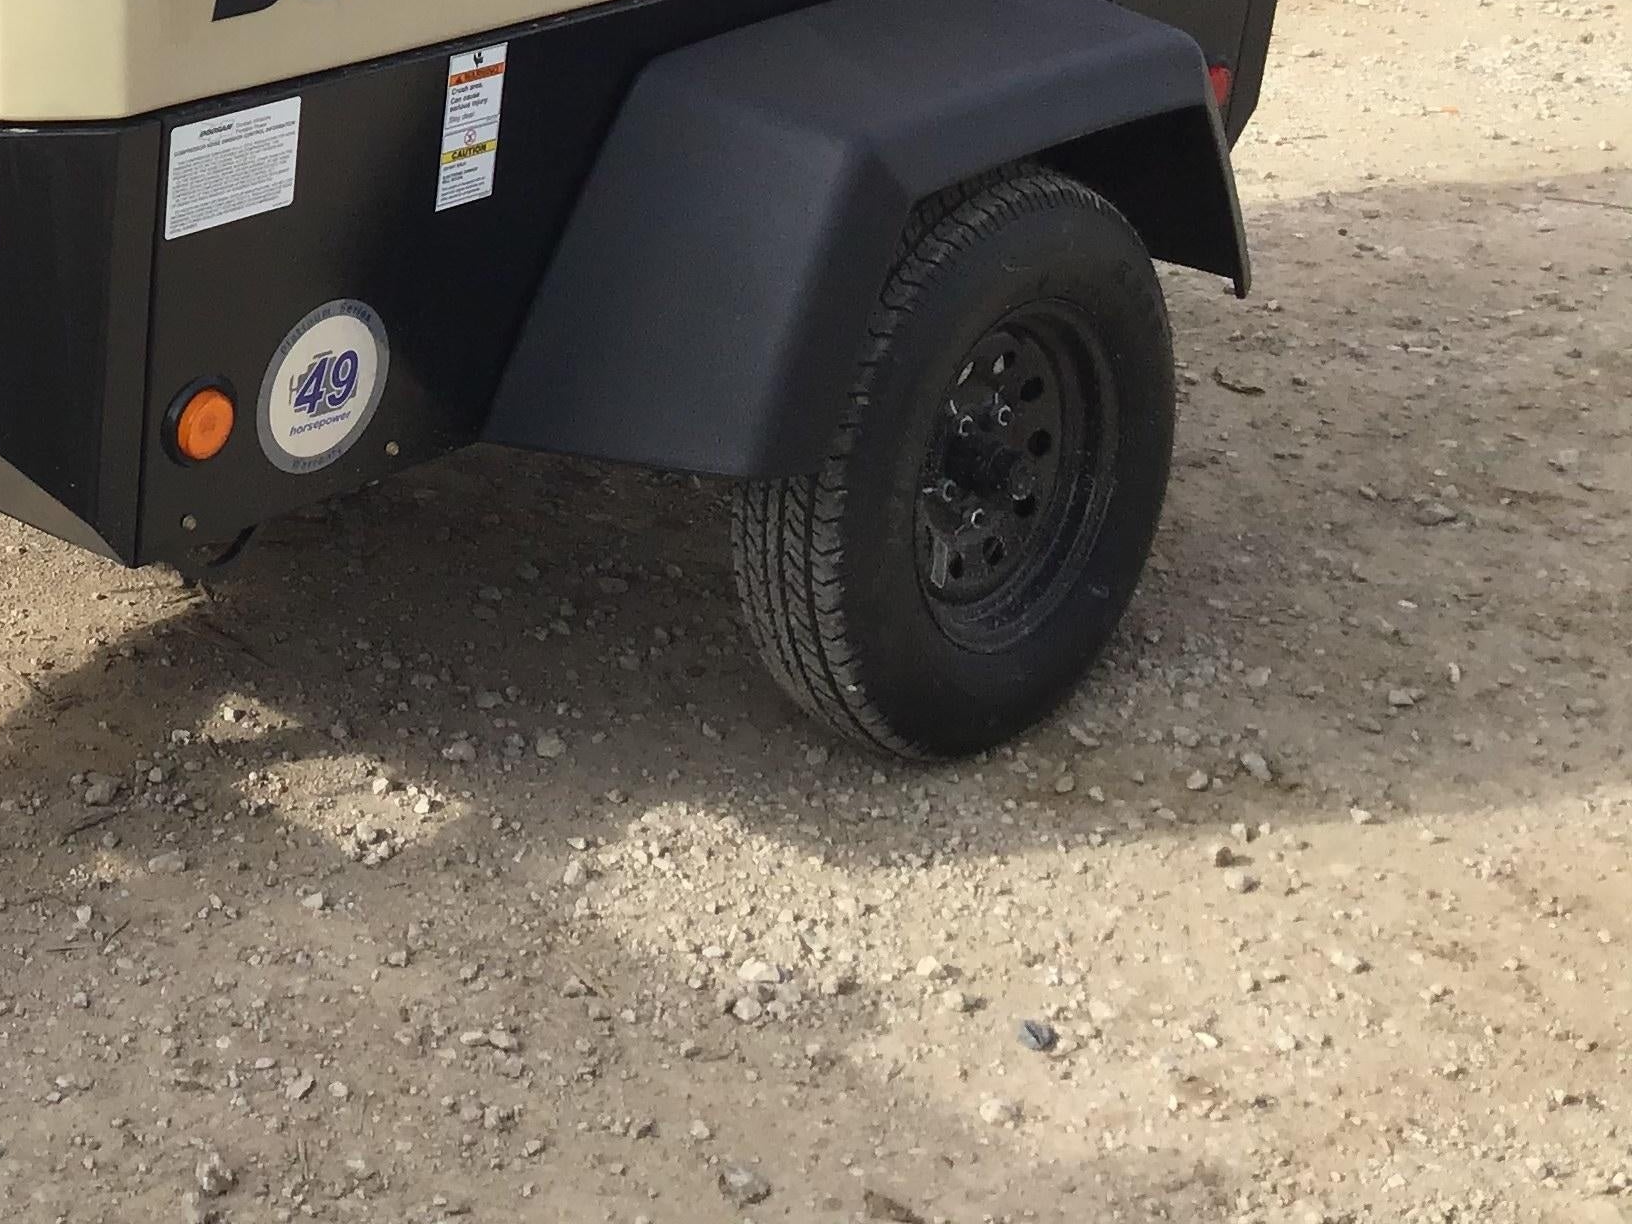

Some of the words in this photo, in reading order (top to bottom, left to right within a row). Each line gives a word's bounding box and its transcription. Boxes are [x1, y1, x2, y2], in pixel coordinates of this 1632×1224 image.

[451, 144, 487, 160] CAUTION
[293, 349, 359, 415] 49
[289, 411, 351, 437] horsepower
